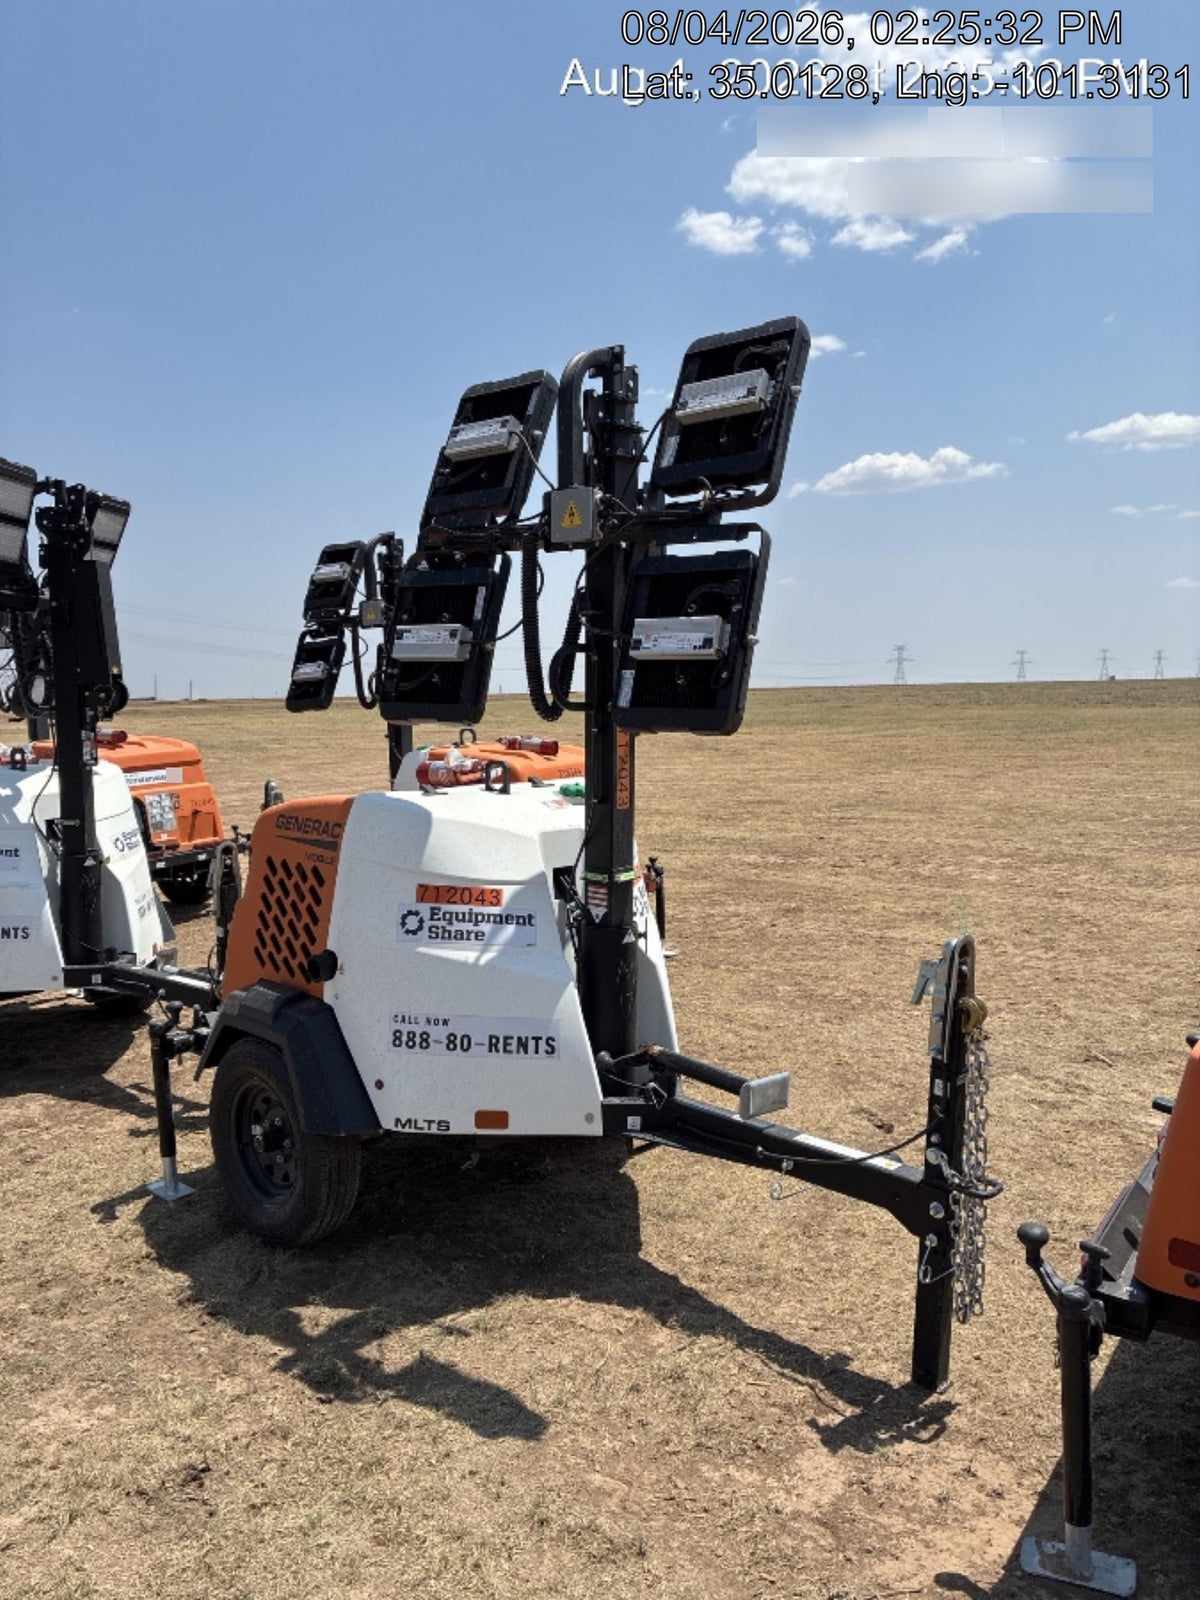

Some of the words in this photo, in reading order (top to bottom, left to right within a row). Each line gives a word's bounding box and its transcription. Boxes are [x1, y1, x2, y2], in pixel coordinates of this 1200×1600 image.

[275, 813, 342, 839] GENERAC
[418, 884, 501, 906] 712043
[429, 906, 536, 927] Equipment
[427, 925, 486, 942] Share
[392, 1014, 420, 1026] CALL
[425, 1016, 451, 1027] NOW
[391, 1029, 557, 1056] 888-80-RENTS
[394, 1117, 451, 1132] MLTS
